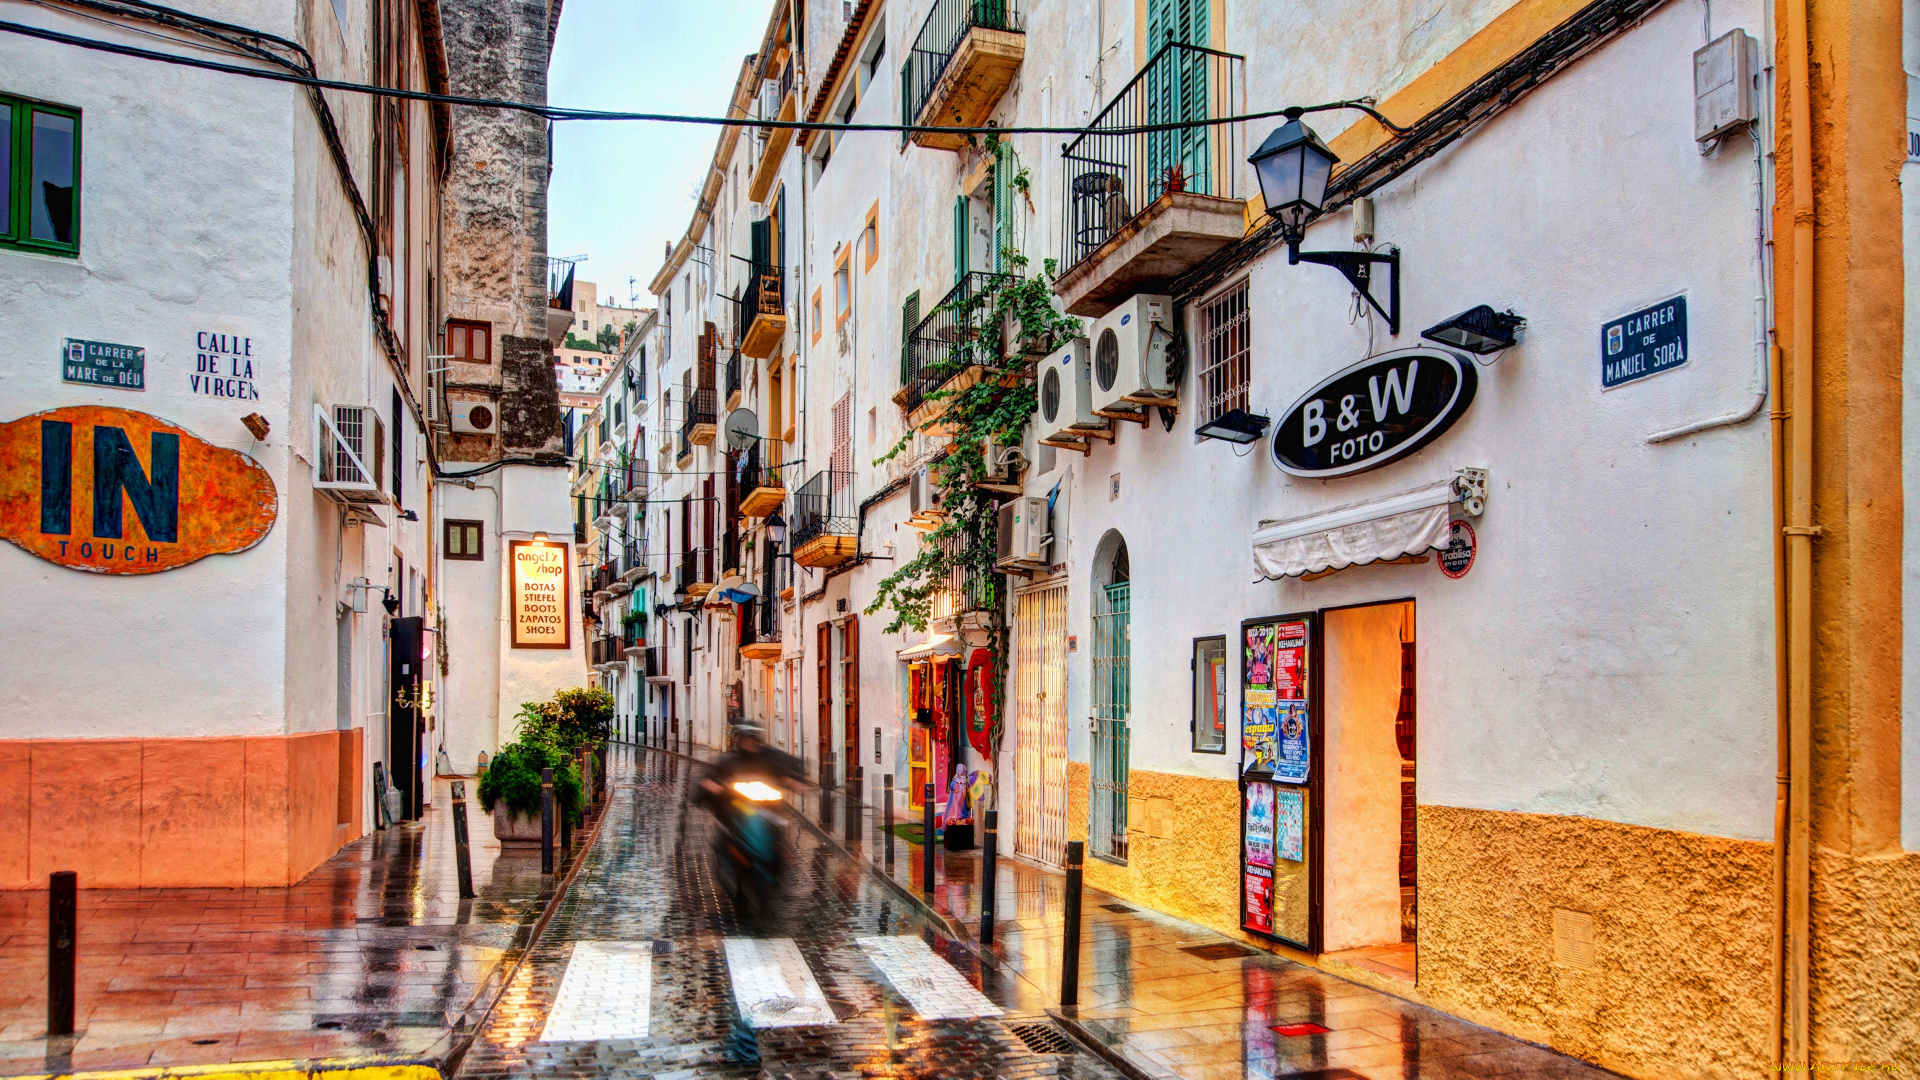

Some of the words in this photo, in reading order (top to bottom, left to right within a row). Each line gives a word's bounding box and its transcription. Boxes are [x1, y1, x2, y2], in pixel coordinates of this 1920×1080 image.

[1628, 305, 1674, 336] CARRER
[197, 331, 254, 357] CALLE
[1643, 333, 1656, 346] DE
[89, 344, 134, 360] CARRER
[1606, 352, 1647, 383] MANUEL
[1653, 335, 1684, 367] SORÀ
[95, 358, 108, 367] DE
[112, 359, 125, 369] LA
[197, 353, 219, 374] DE
[232, 358, 254, 379] LA
[67, 366, 98, 381] MARE
[102, 375, 115, 383] DE
[118, 369, 141, 386] DÉU
[190, 374, 260, 401] VIRGEN
[1303, 398, 1327, 448] B
[1336, 394, 1360, 432] &
[1368, 359, 1419, 423] W
[1330, 430, 1385, 465] FOTO
[40, 419, 181, 544] IN
[58, 540, 158, 563] TOUCH
[1441, 548, 1471, 561] Trablisa
[536, 563, 563, 577] shop
[524, 582, 556, 592] BOTAS
[524, 593, 556, 602] STIEFEL
[524, 604, 557, 613] BOOTS
[519, 614, 562, 624] ZAPATOS
[526, 625, 556, 634] SHOES
[1244, 722, 1275, 736] espuma
